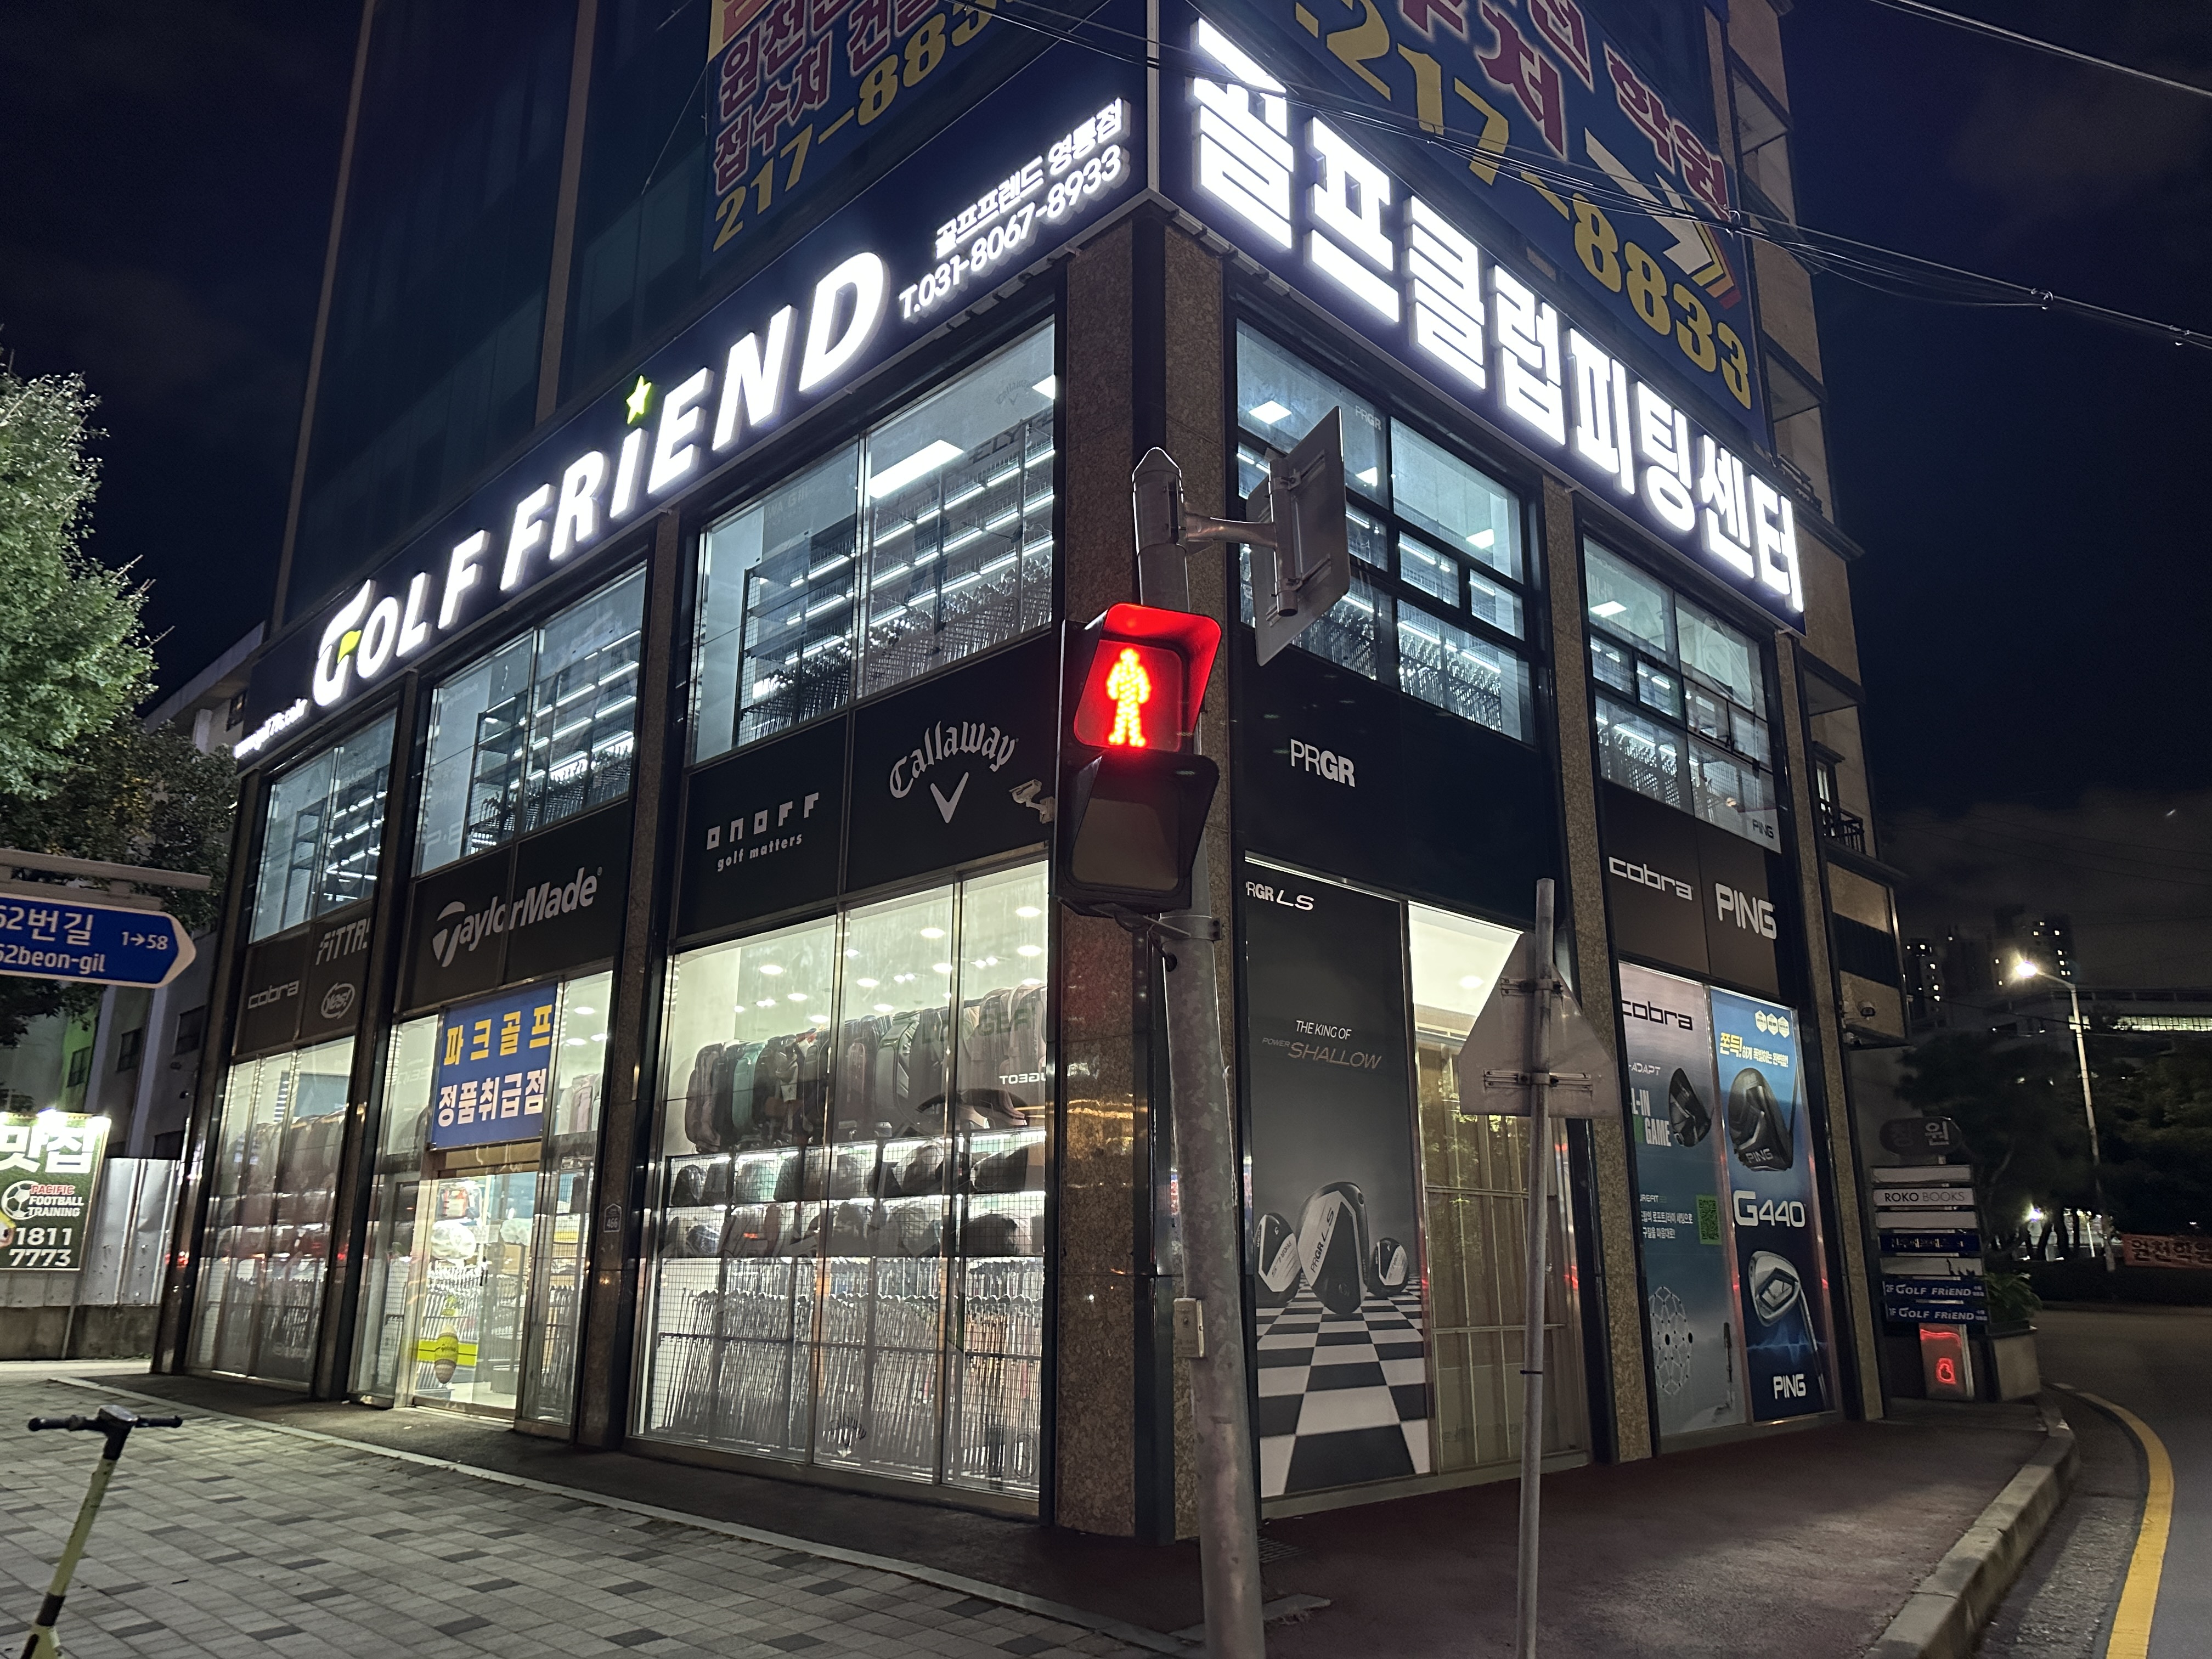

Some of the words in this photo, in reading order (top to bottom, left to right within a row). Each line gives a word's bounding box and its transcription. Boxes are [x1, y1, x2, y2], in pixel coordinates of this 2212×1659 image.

[714, 0, 1004, 252] 217-883
[715, 35, 831, 193] 접수처
[935, 155, 1043, 259] 골프프렌드
[1355, 405, 1381, 431] PRGR
[313, 529, 494, 707] GOLF
[889, 720, 1017, 799] Callaway
[1290, 738, 1356, 787] PRGR
[1752, 819, 1774, 839] PING
[717, 847, 744, 872] golf
[749, 832, 803, 859] matters
[1608, 856, 1693, 901] cobra
[1246, 881, 1274, 902] RGR
[1276, 889, 1315, 911] LS
[1715, 882, 1778, 940] PING
[432, 866, 598, 968] TaylorMade
[247, 980, 300, 1009] cobra
[443, 1004, 553, 1066] 파크골프
[1296, 1020, 1314, 1035] THE
[1315, 1023, 1338, 1038] KING
[1338, 1028, 1352, 1041] OF
[1261, 1037, 1290, 1048] POWER
[1288, 1042, 1383, 1070] SHALLOW
[437, 1068, 548, 1127] 정품취급점
[1631, 1087, 1651, 1117] L-IN
[1644, 1117, 1672, 1147] GAME
[1746, 1148, 1774, 1164] PING
[28, 1196, 84, 1206] FOOTBALL
[30, 1184, 76, 1195] PACIFIC
[1884, 1192, 1918, 1203] ROKO
[1922, 1191, 1965, 1203] BOOKS
[27, 1206, 81, 1217] TRAINING
[1733, 1190, 1805, 1228] G440
[15, 1227, 72, 1245] 1811
[9, 1248, 72, 1267] 7773
[1310, 1241, 1324, 1273] PRGR
[1895, 1283, 1927, 1296] GOLF
[1898, 1307, 1930, 1320] GOLF
[1773, 1373, 1807, 1400] PING
